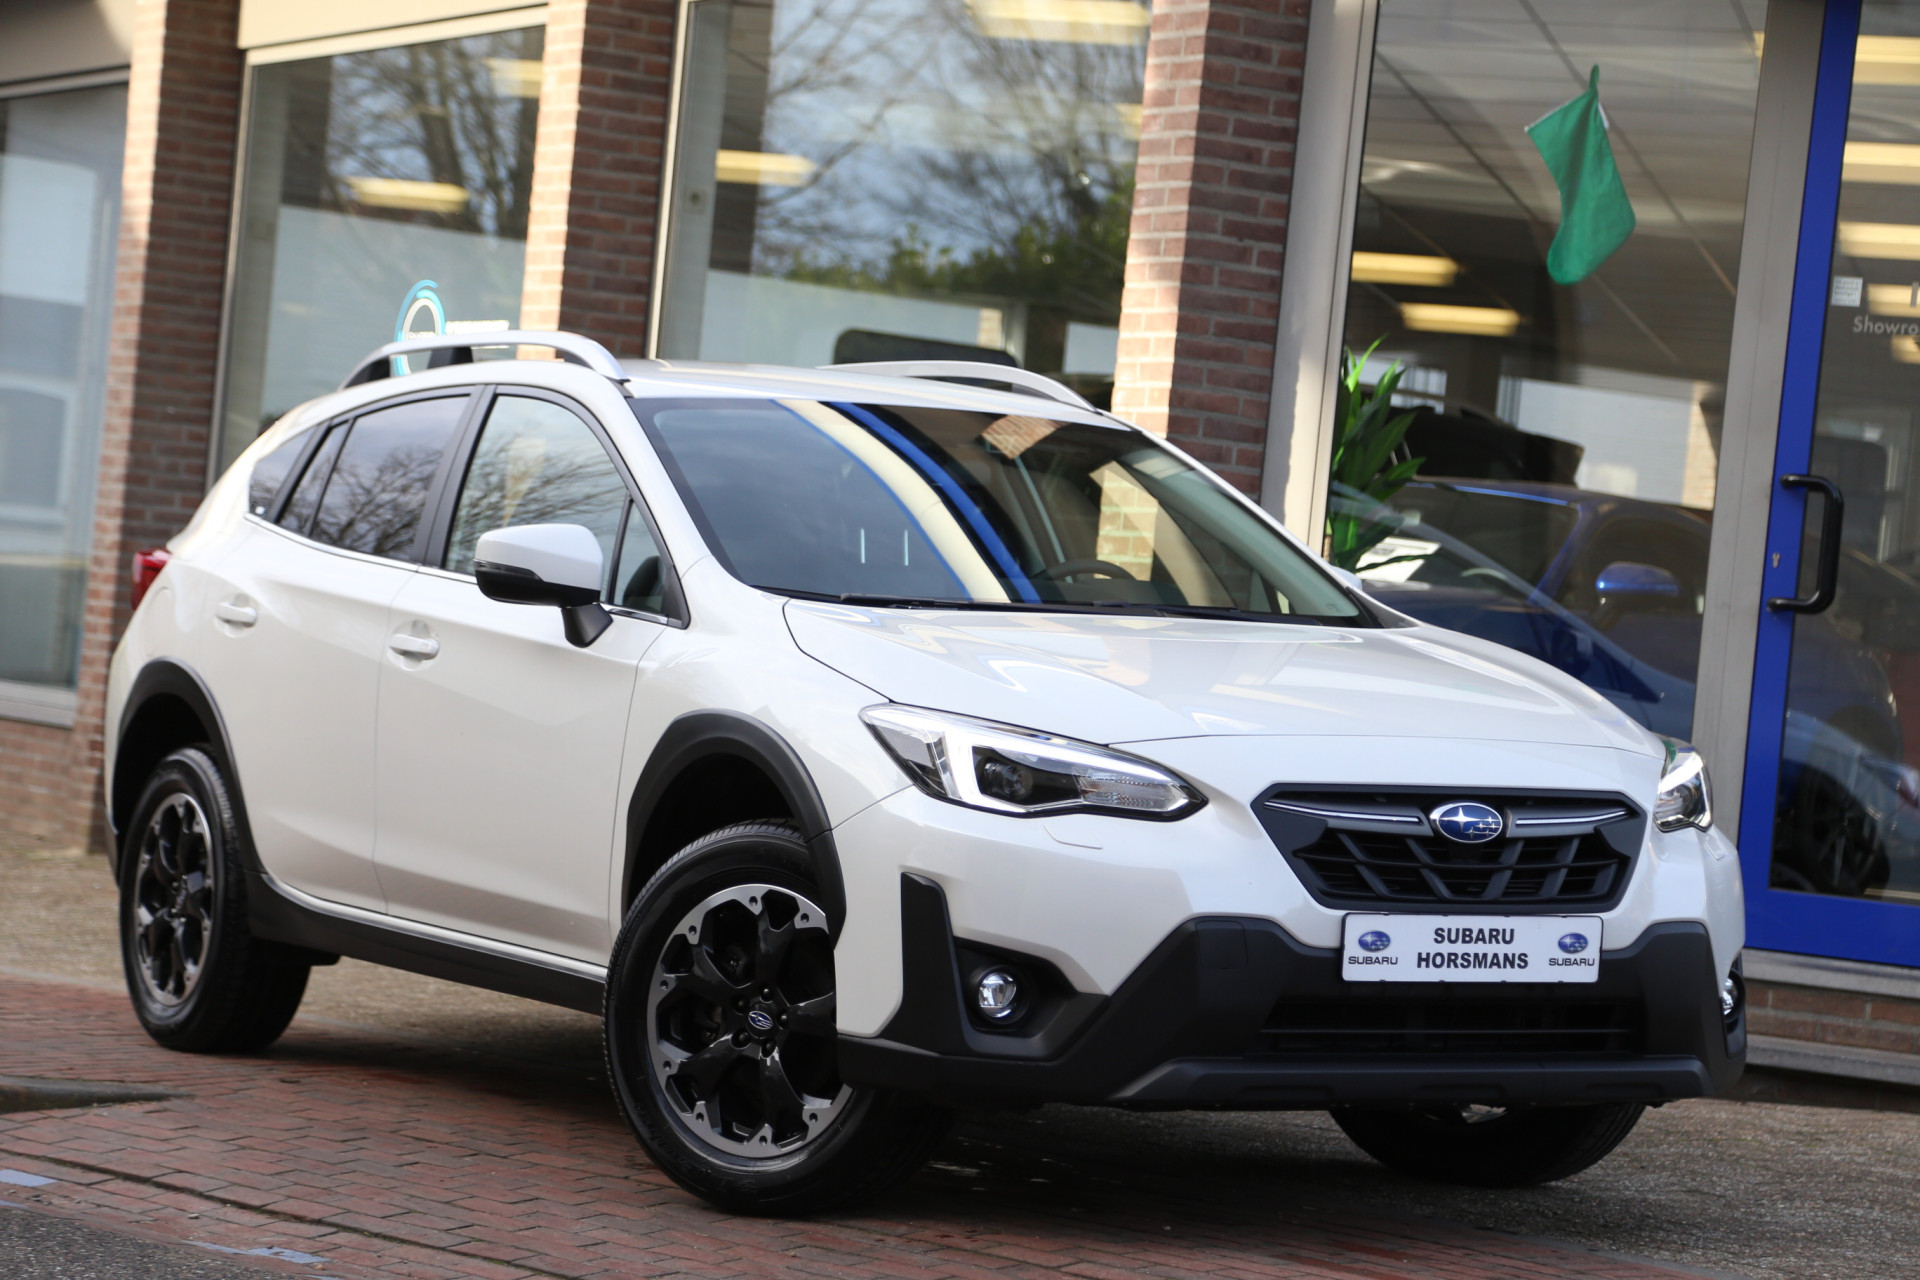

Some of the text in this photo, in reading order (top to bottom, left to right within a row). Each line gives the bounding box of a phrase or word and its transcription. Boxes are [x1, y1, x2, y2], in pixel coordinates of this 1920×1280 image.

[1433, 927, 1515, 945] SUBARU
[1348, 956, 1398, 965] SUBARU
[1416, 951, 1529, 969] HORSMANS
[1548, 957, 1595, 967] SUBARU
